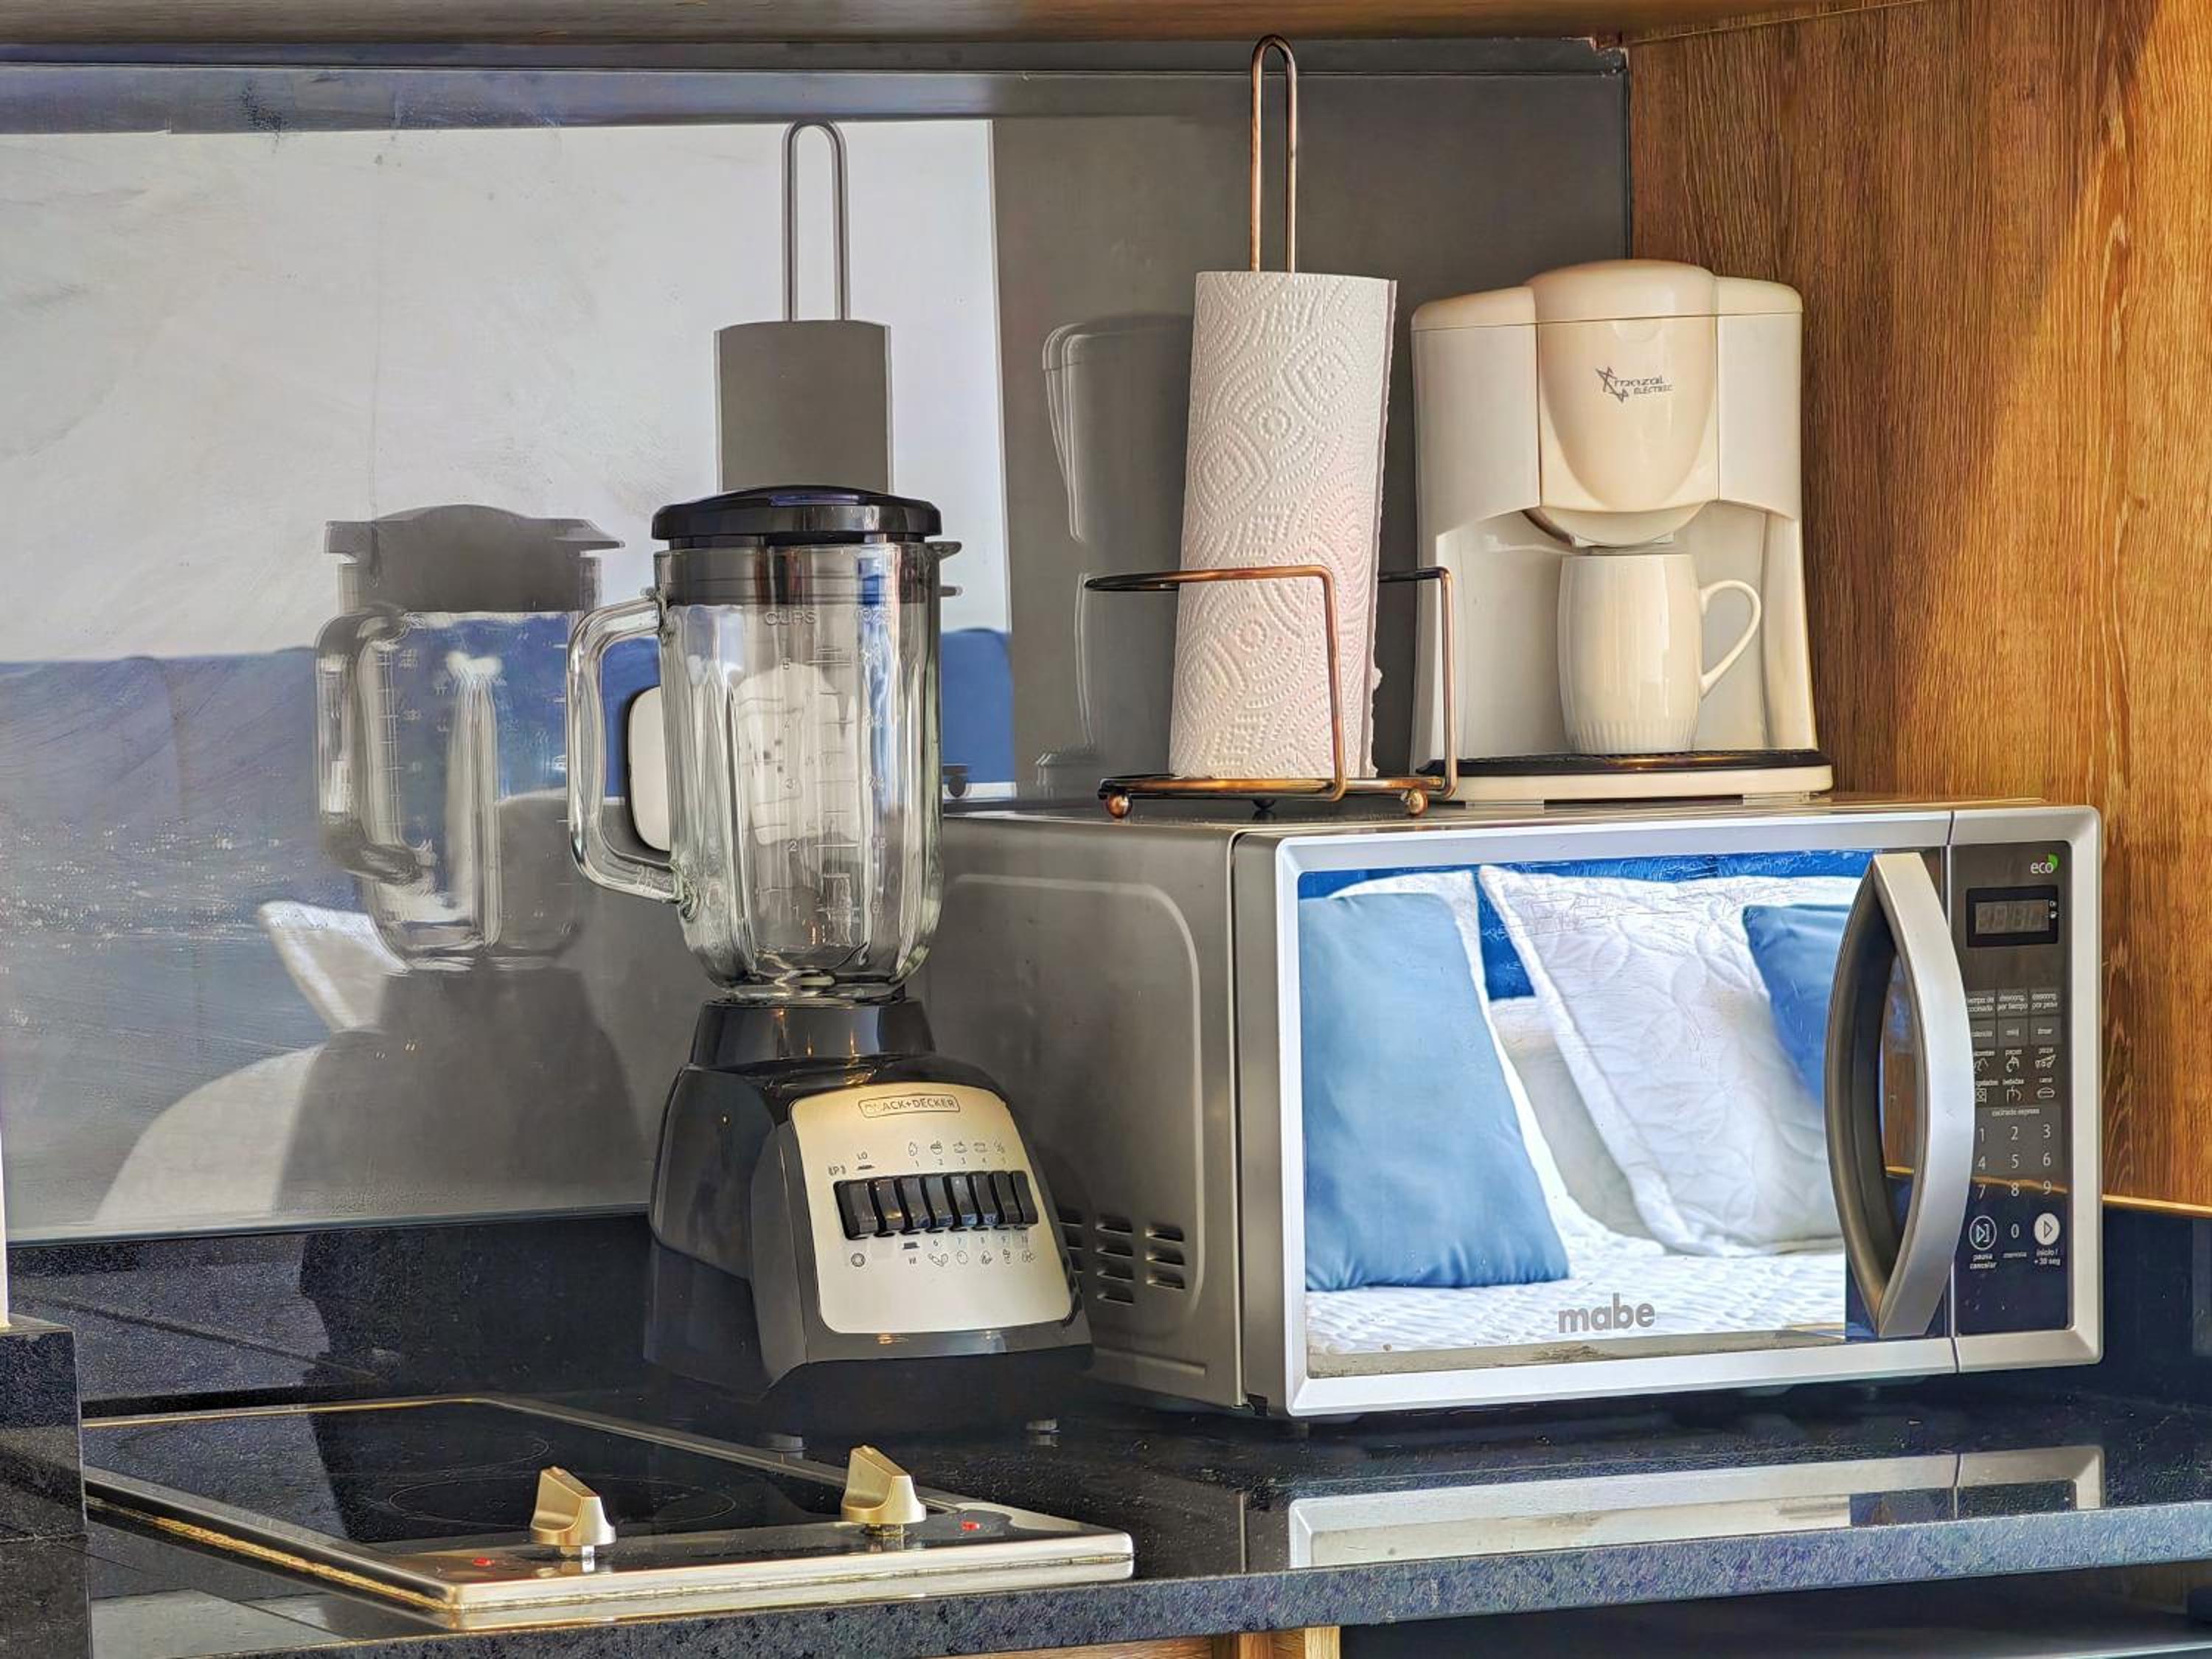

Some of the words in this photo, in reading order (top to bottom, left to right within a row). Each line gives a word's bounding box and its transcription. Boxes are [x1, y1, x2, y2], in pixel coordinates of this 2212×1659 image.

[1632, 384, 1673, 395] ELECTRIC
[765, 610, 816, 626] CUPS
[788, 839, 798, 852] 2
[2030, 862, 2053, 874] eco
[1979, 1127, 1985, 1142] 1
[2011, 1127, 2019, 1141] 2
[2043, 1124, 2051, 1138] 3
[1978, 1155, 1986, 1169] 4
[2011, 1154, 2019, 1169] 5
[2042, 1152, 2051, 1166] 6
[1978, 1184, 1986, 1200] 7
[2011, 1183, 2019, 1197] 8
[2043, 1180, 2052, 1195] 9
[2011, 1223, 2020, 1239] 0
[1558, 1292, 1655, 1333] mabe
